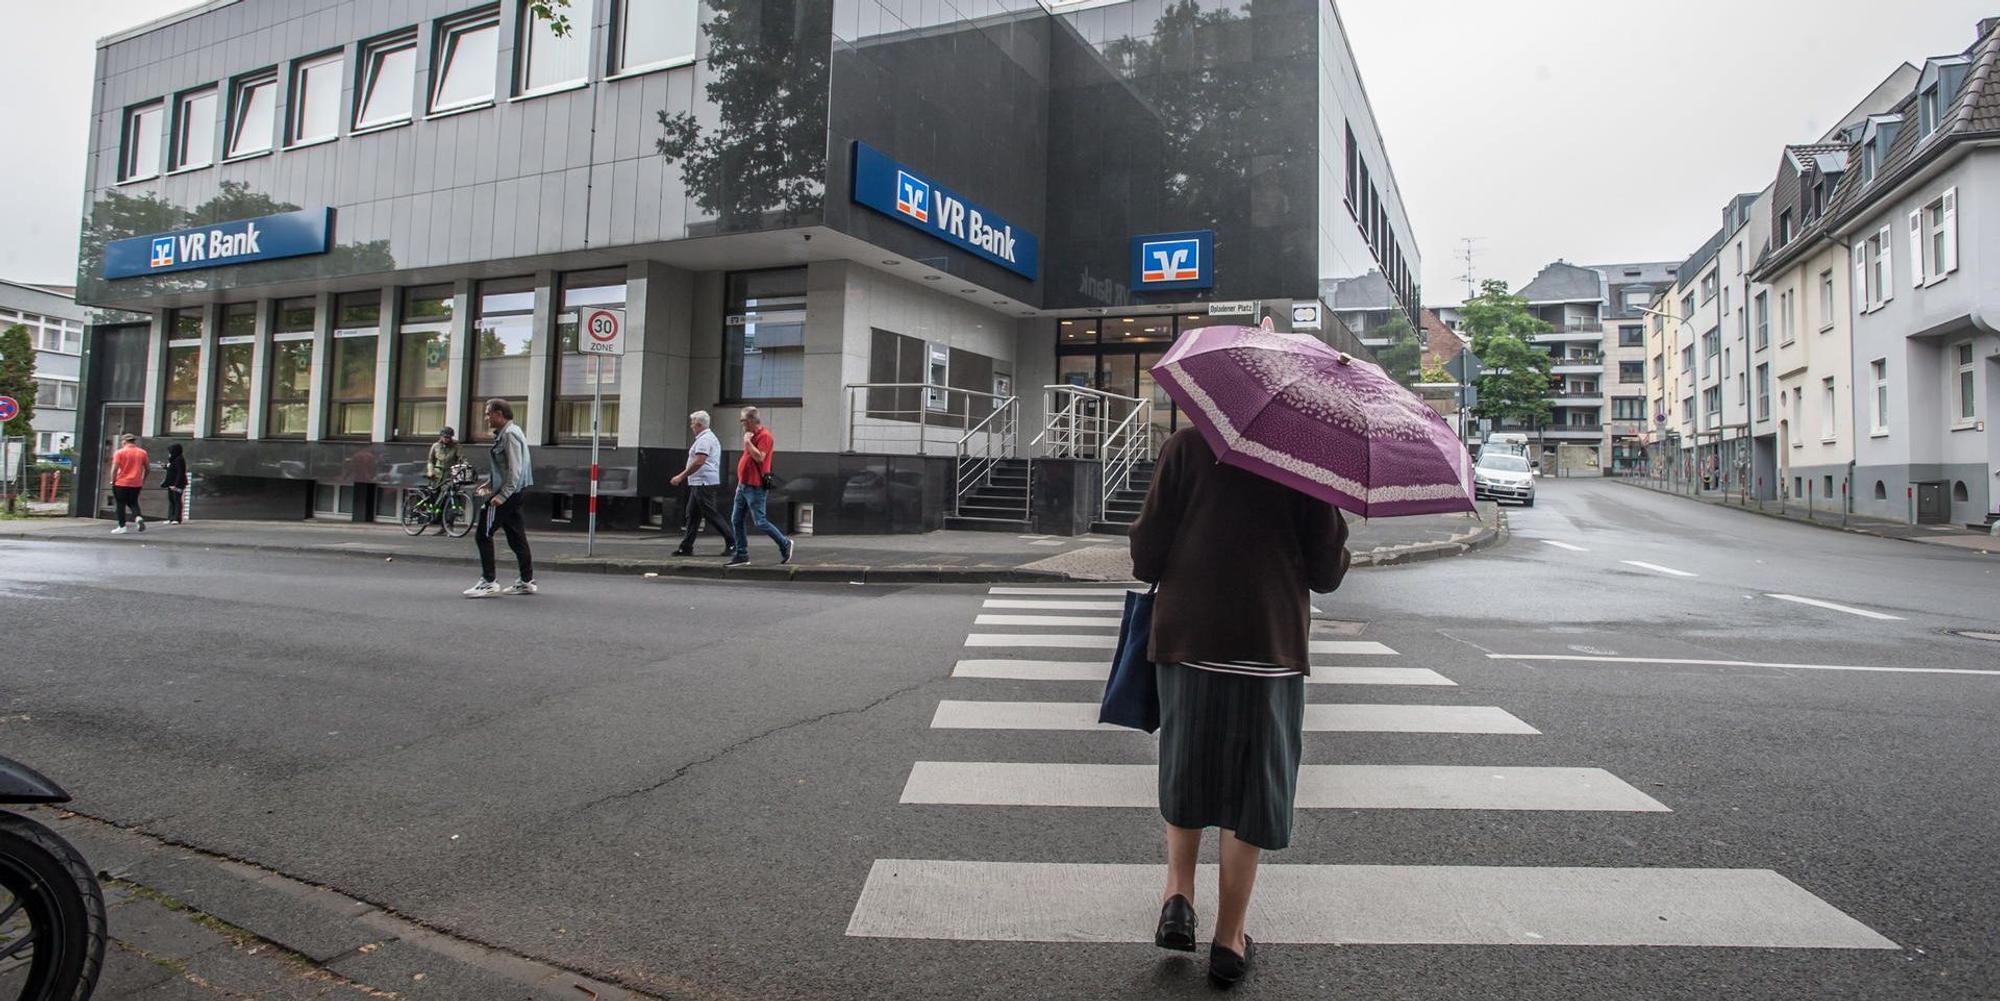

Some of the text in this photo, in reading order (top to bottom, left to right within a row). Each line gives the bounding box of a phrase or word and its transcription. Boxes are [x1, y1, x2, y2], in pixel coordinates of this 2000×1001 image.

[934, 190, 1015, 263] VR Bank
[179, 222, 261, 262] VR Bank
[1238, 304, 1252, 312] Platz
[594, 319, 612, 334] 30
[591, 343, 614, 352] ZONE
